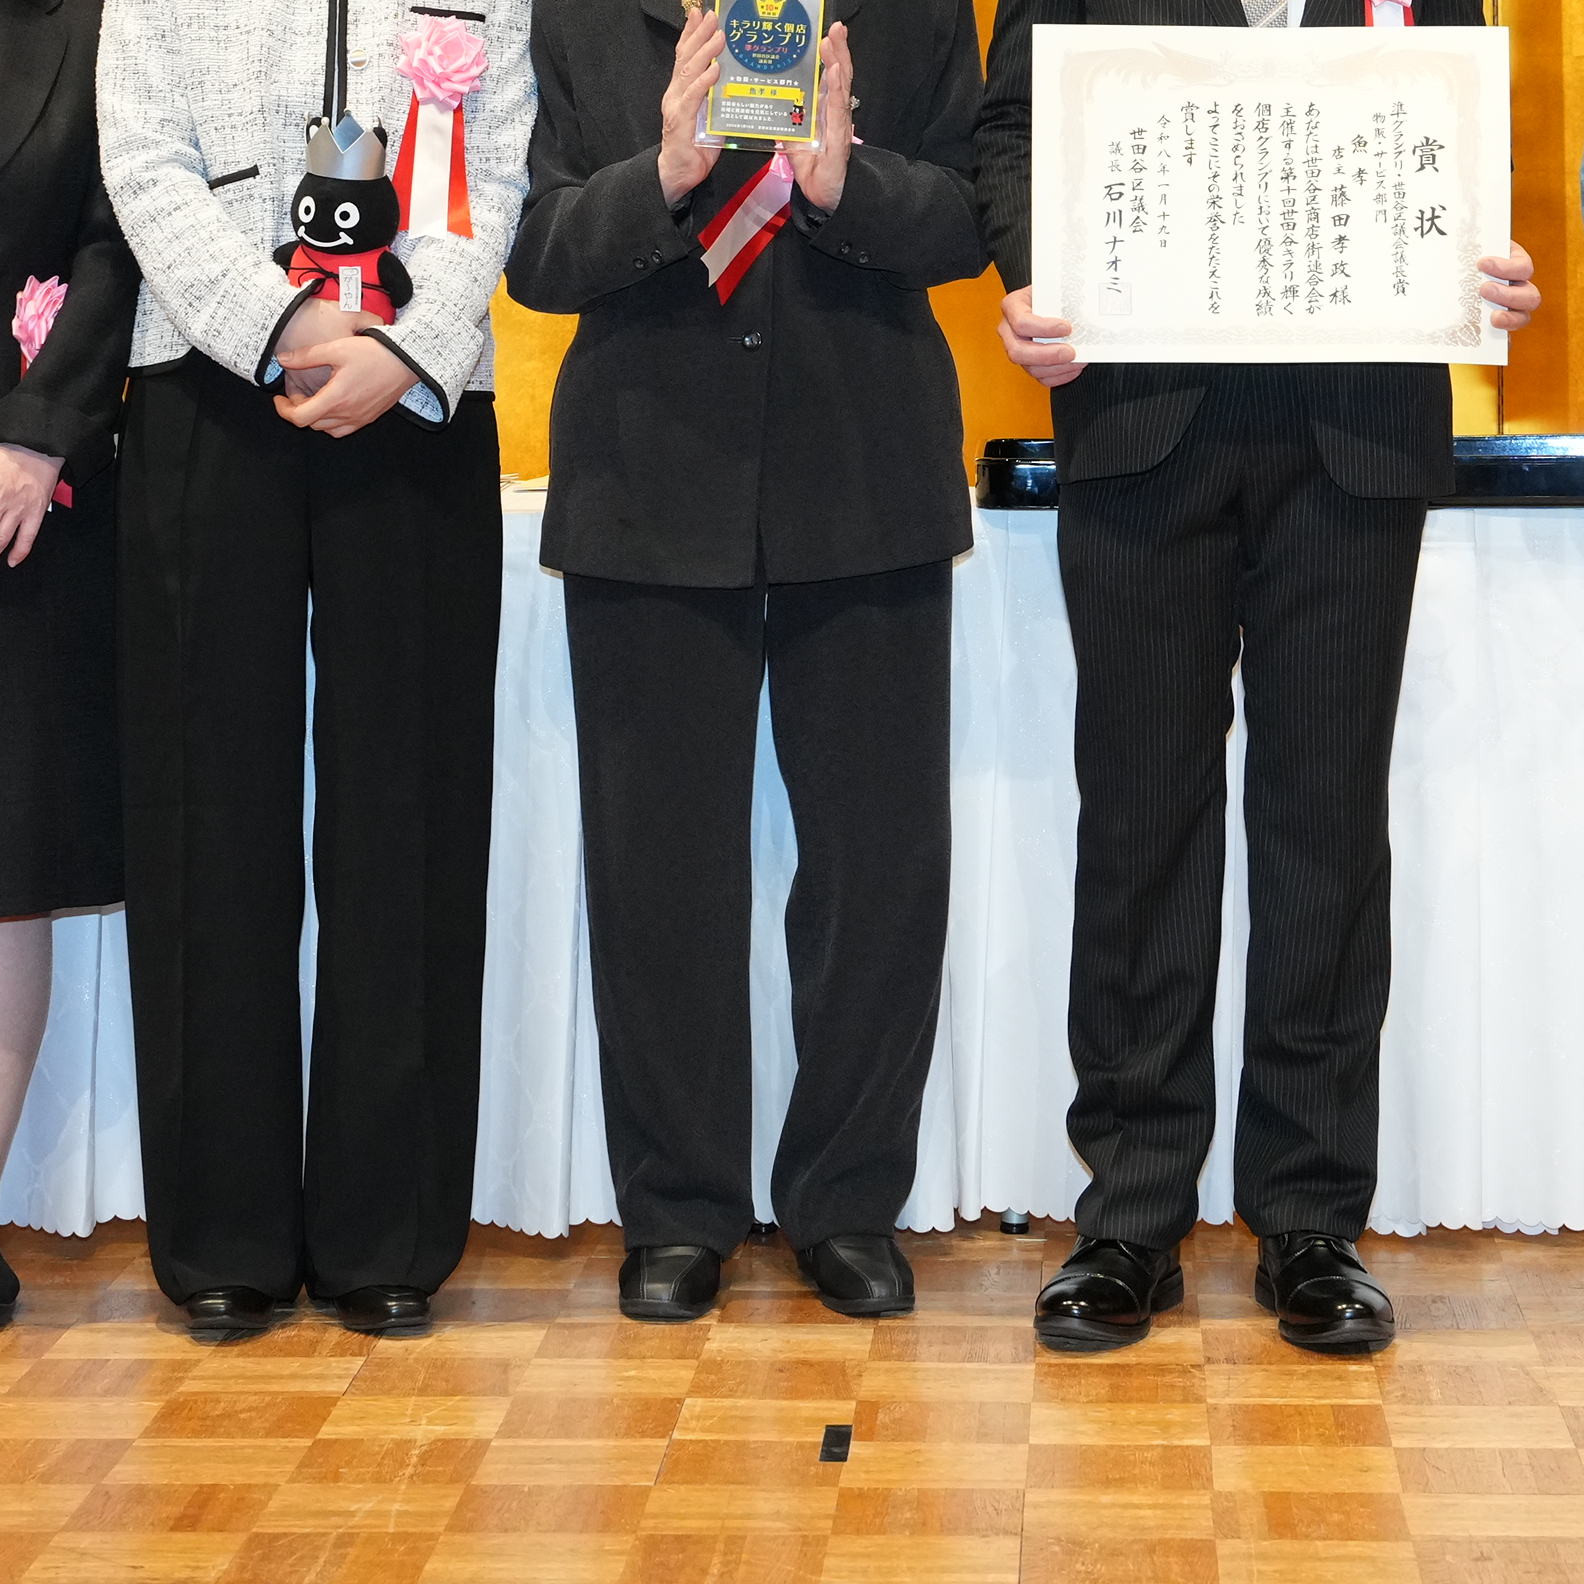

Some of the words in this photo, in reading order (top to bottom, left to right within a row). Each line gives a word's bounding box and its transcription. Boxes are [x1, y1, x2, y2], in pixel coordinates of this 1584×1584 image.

[729, 19, 807, 33] キラリ輝く個店
[729, 28, 806, 47] グランプリ
[1128, 127, 1148, 233] 世田谷区議会
[1157, 115, 1171, 247] 令和八年一月十九日
[1181, 101, 1199, 167] 賞します
[1232, 103, 1246, 225] をおさめられました
[1351, 134, 1368, 186] 魚孝
[1372, 112, 1387, 223] 物販・サービス部門
[1412, 136, 1447, 238] 賞状
[1205, 101, 1225, 314] よってここにその栄誉をたたえこれを
[1254, 102, 1275, 316] 個店グランプリにおいて優秀な成績
[1279, 103, 1299, 315] 主催する第十回世田谷キラリ輝く
[1302, 102, 1324, 314] あなたは世田谷区商店街連合会が
[1390, 101, 1409, 296] 準グランプリ・世田谷区議会議長賞
